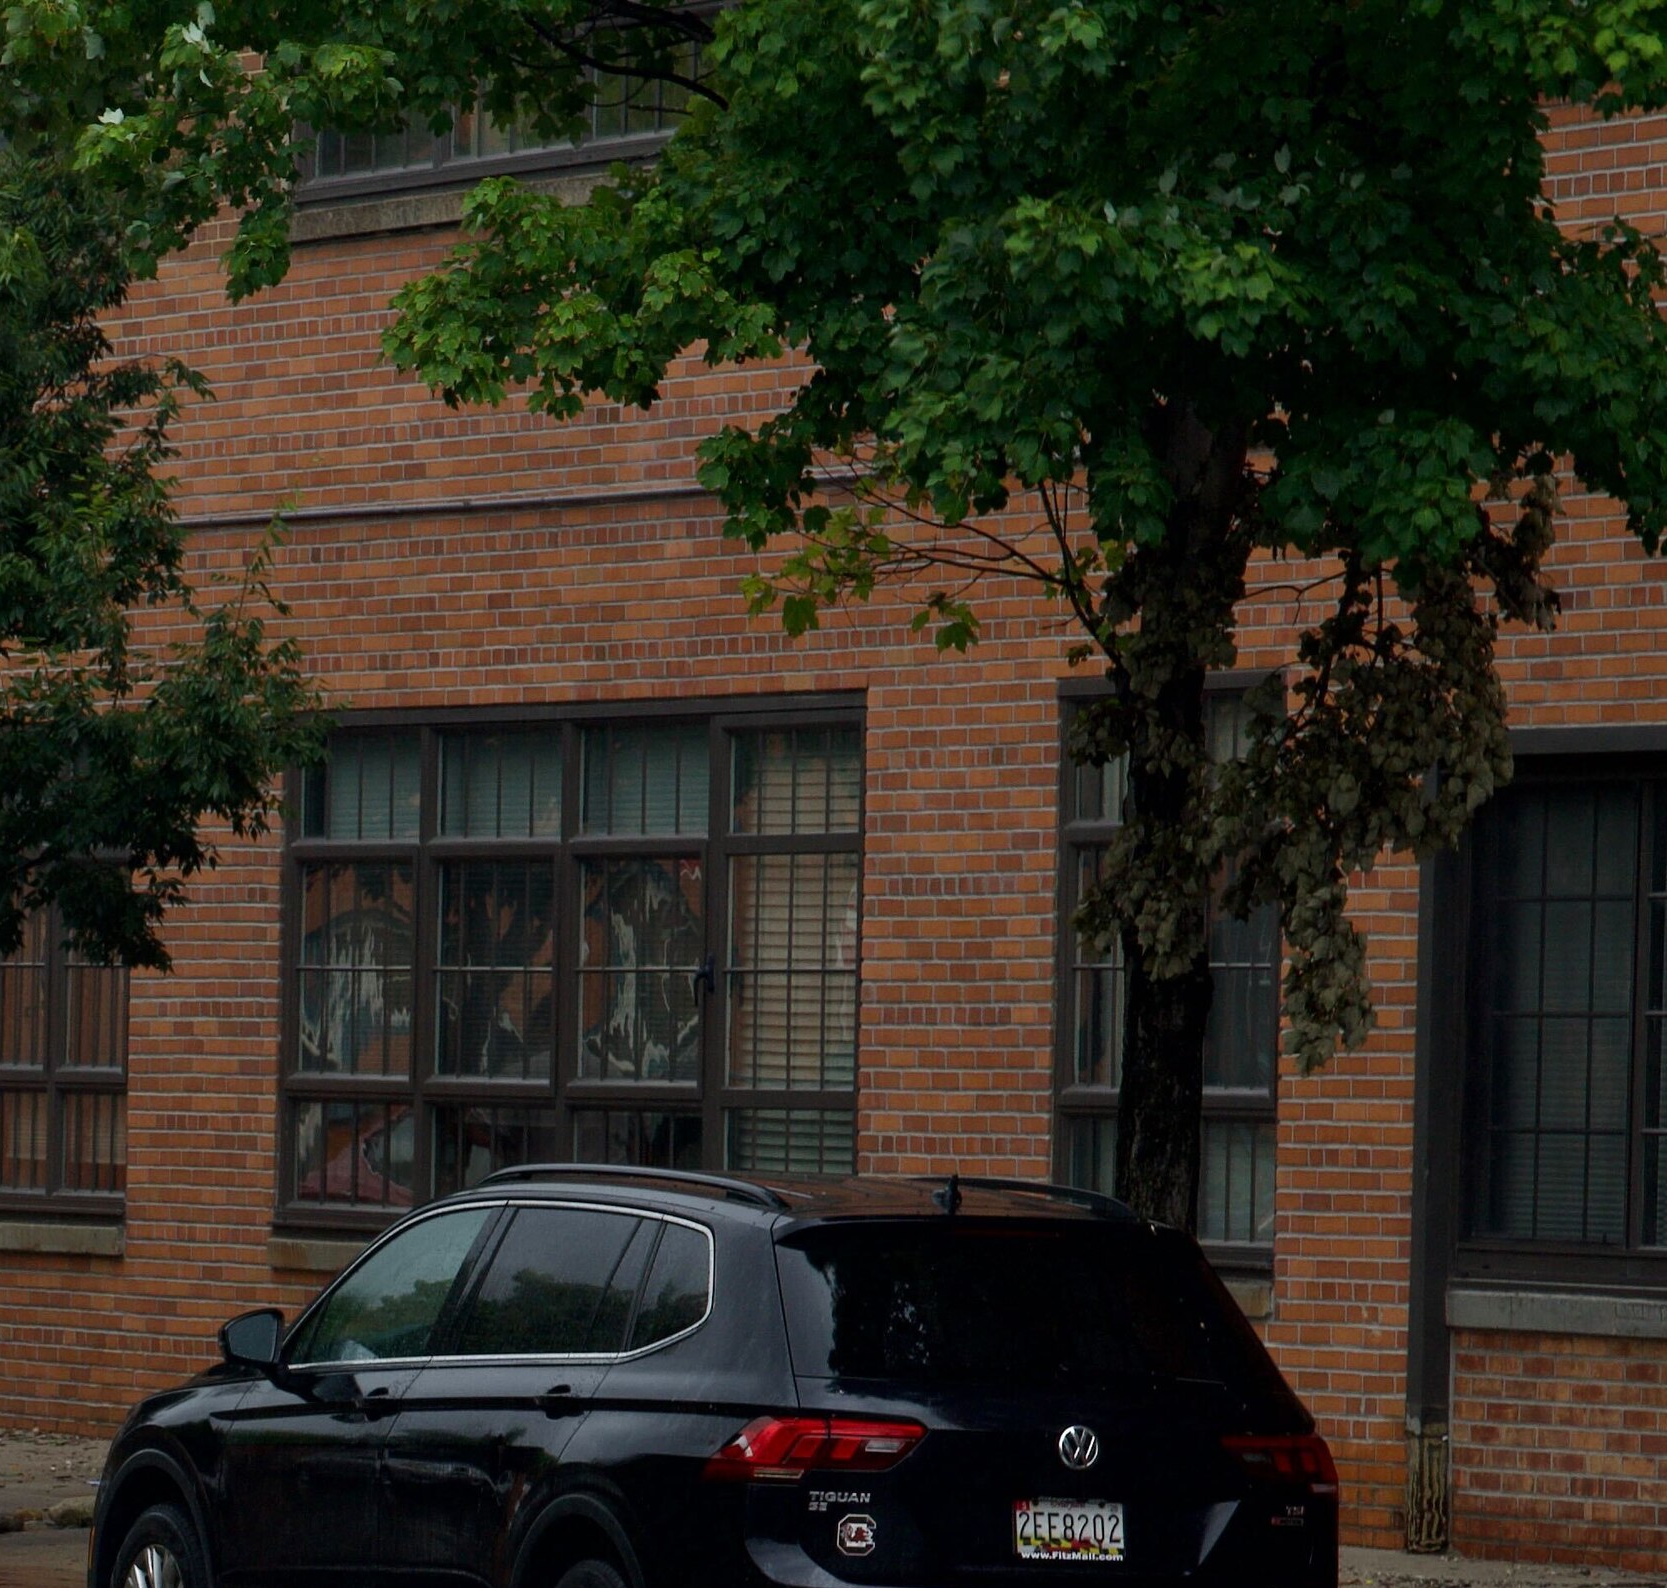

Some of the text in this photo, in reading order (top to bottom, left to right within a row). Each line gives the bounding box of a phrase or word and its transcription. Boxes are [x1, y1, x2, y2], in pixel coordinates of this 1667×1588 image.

[808, 1490, 872, 1504] TIGUAN
[1018, 1511, 1122, 1544] 2EE8202
[1020, 1551, 1125, 1562] www.FitzMall.com
